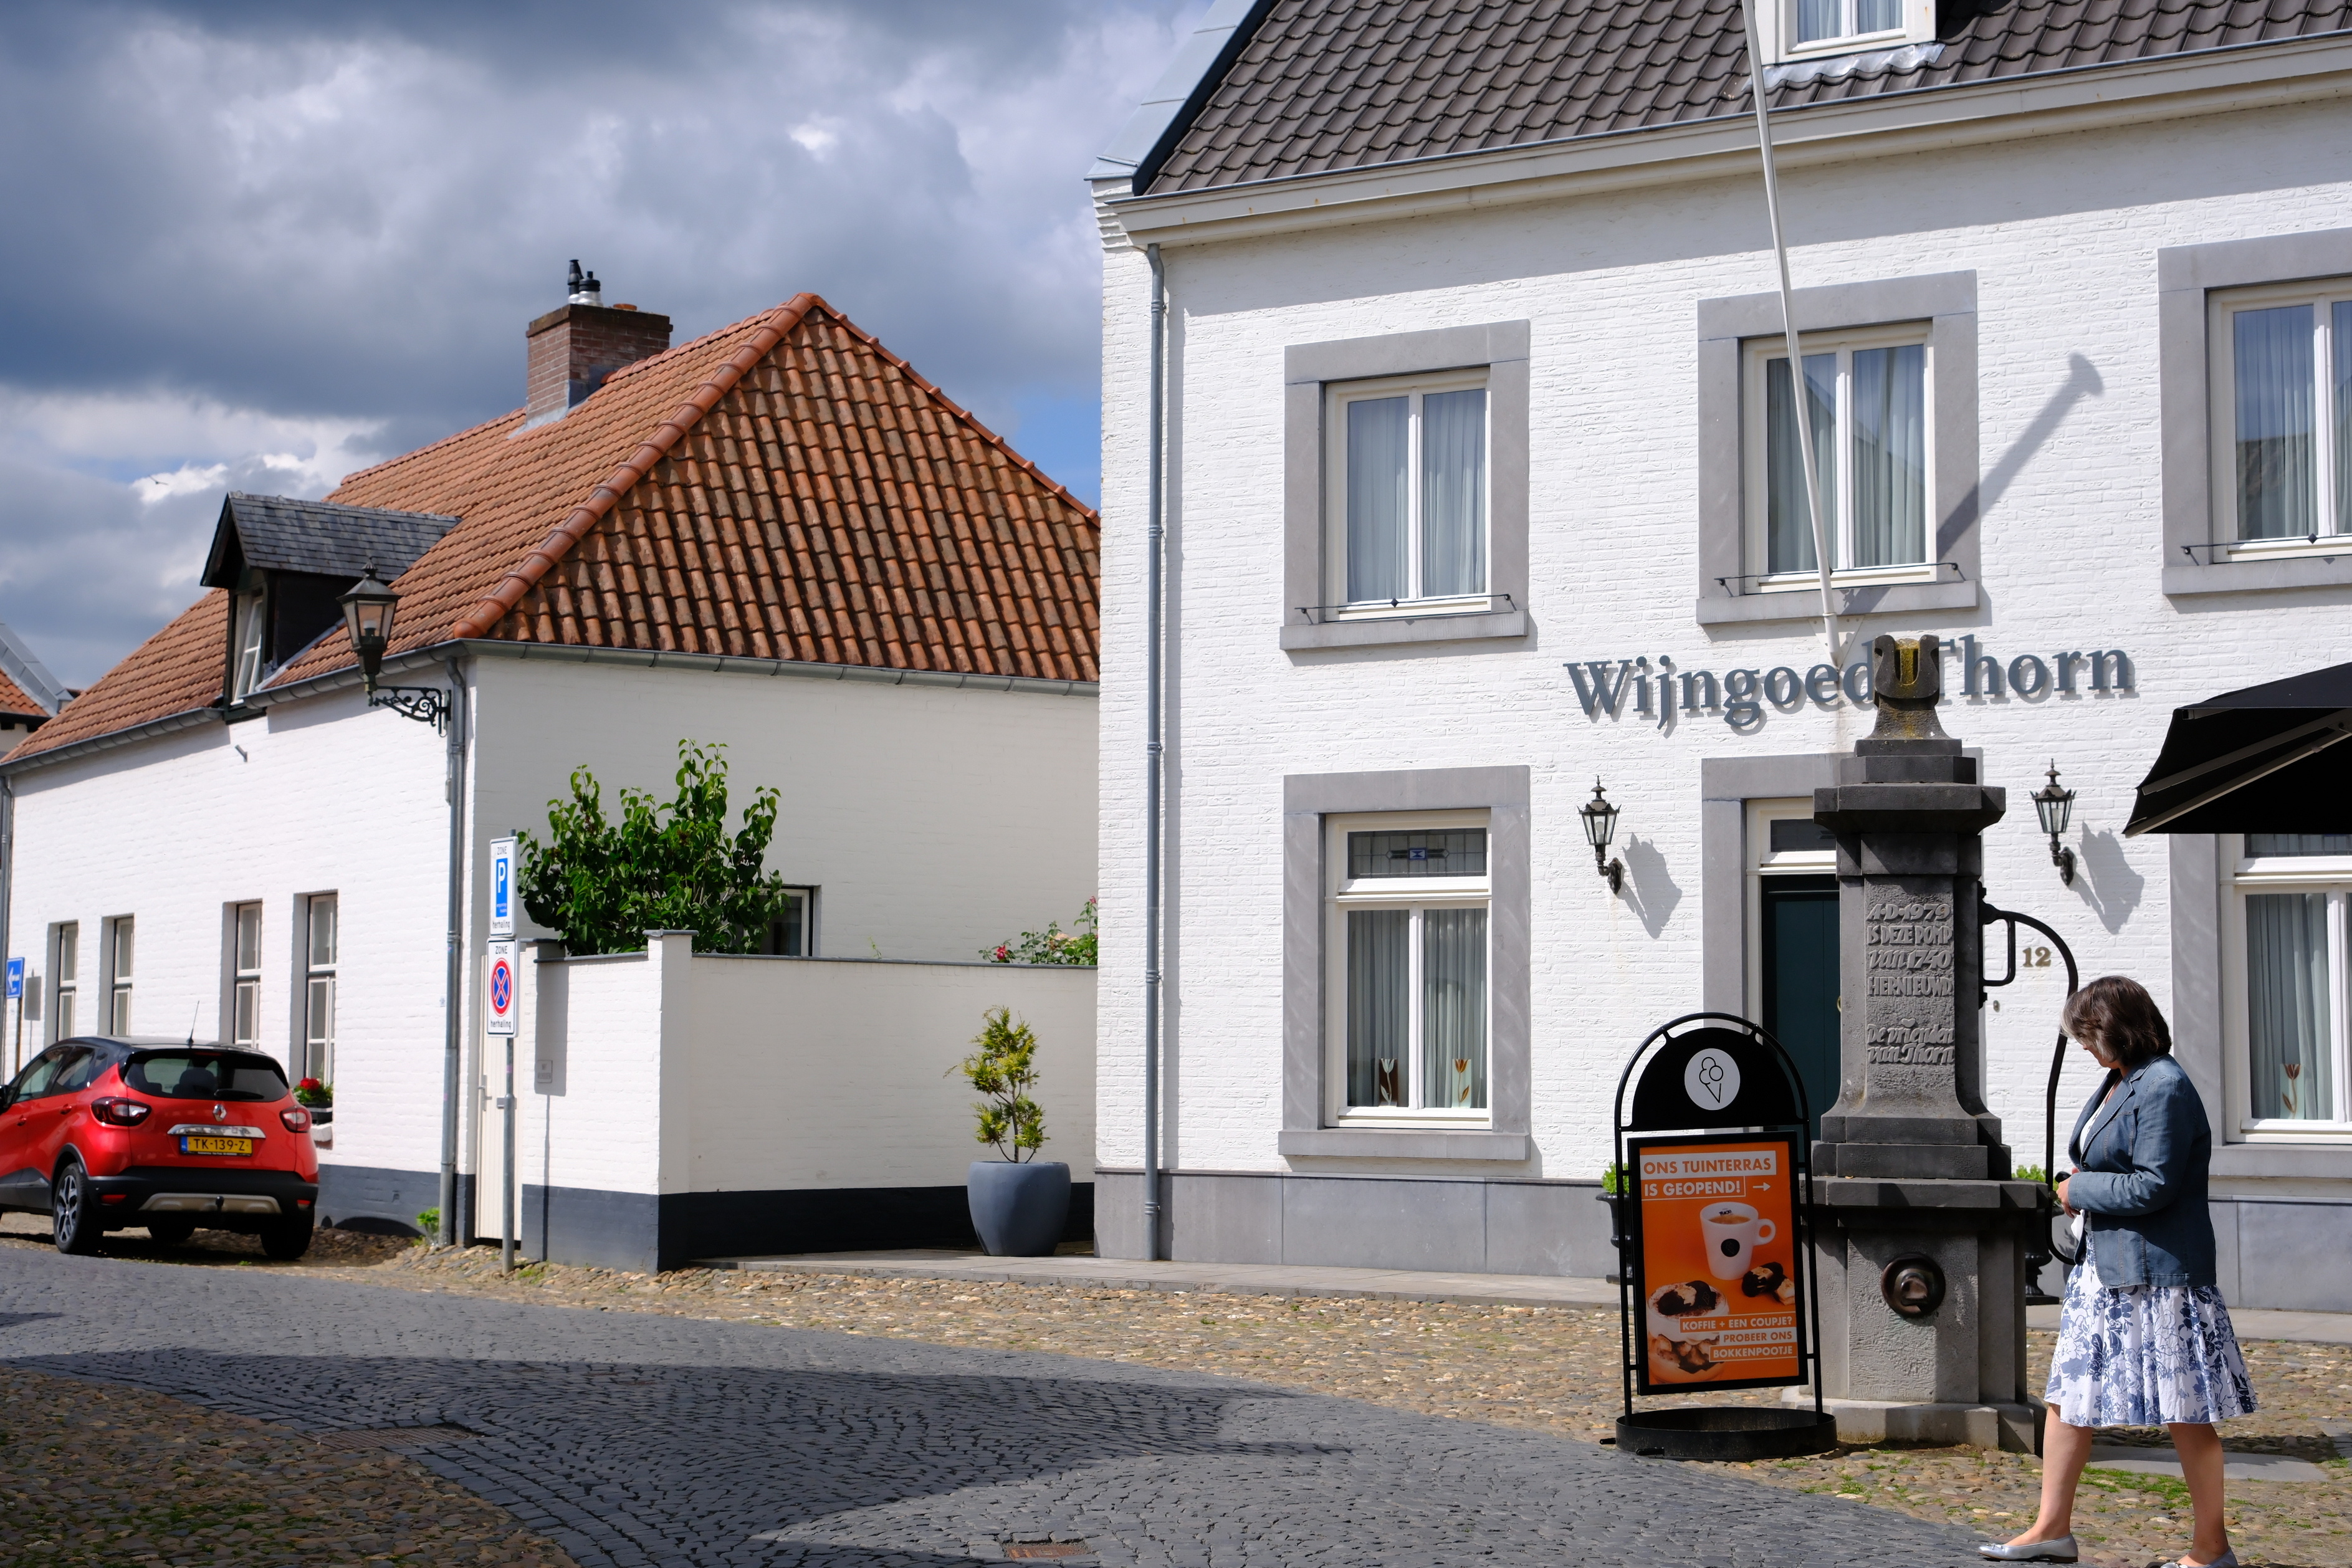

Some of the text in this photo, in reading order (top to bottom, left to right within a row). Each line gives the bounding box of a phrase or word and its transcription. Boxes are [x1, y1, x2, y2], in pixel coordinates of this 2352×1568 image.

[1562, 640, 1875, 730] Wijngoed
[497, 846, 507, 856] ZONE
[498, 861, 506, 894] P
[492, 920, 510, 930] herhaling
[1867, 925, 1953, 945] IS DEZE POMP
[495, 945, 508, 955] ZONE
[2022, 946, 2052, 968] 12
[1868, 949, 1952, 970] van 1740
[1868, 976, 1953, 997] HERNIEUWD
[490, 1019, 512, 1030] herhaling
[1867, 1023, 1954, 1045] De vrienden
[1867, 1042, 1954, 1065] van Thorn
[193, 1139, 246, 1151] TK-139-Z
[1643, 1157, 1771, 1175] ONS TUINTERRAS
[1645, 1180, 1741, 1197] IS GEOPEND!
[1683, 1320, 1716, 1331] KOFFIE
[1729, 1319, 1747, 1329] EEN
[1750, 1316, 1793, 1327] COUPJE?
[1723, 1331, 1792, 1342] PROBEER ONS
[1714, 1346, 1793, 1358] BOKKENPOOTJE
